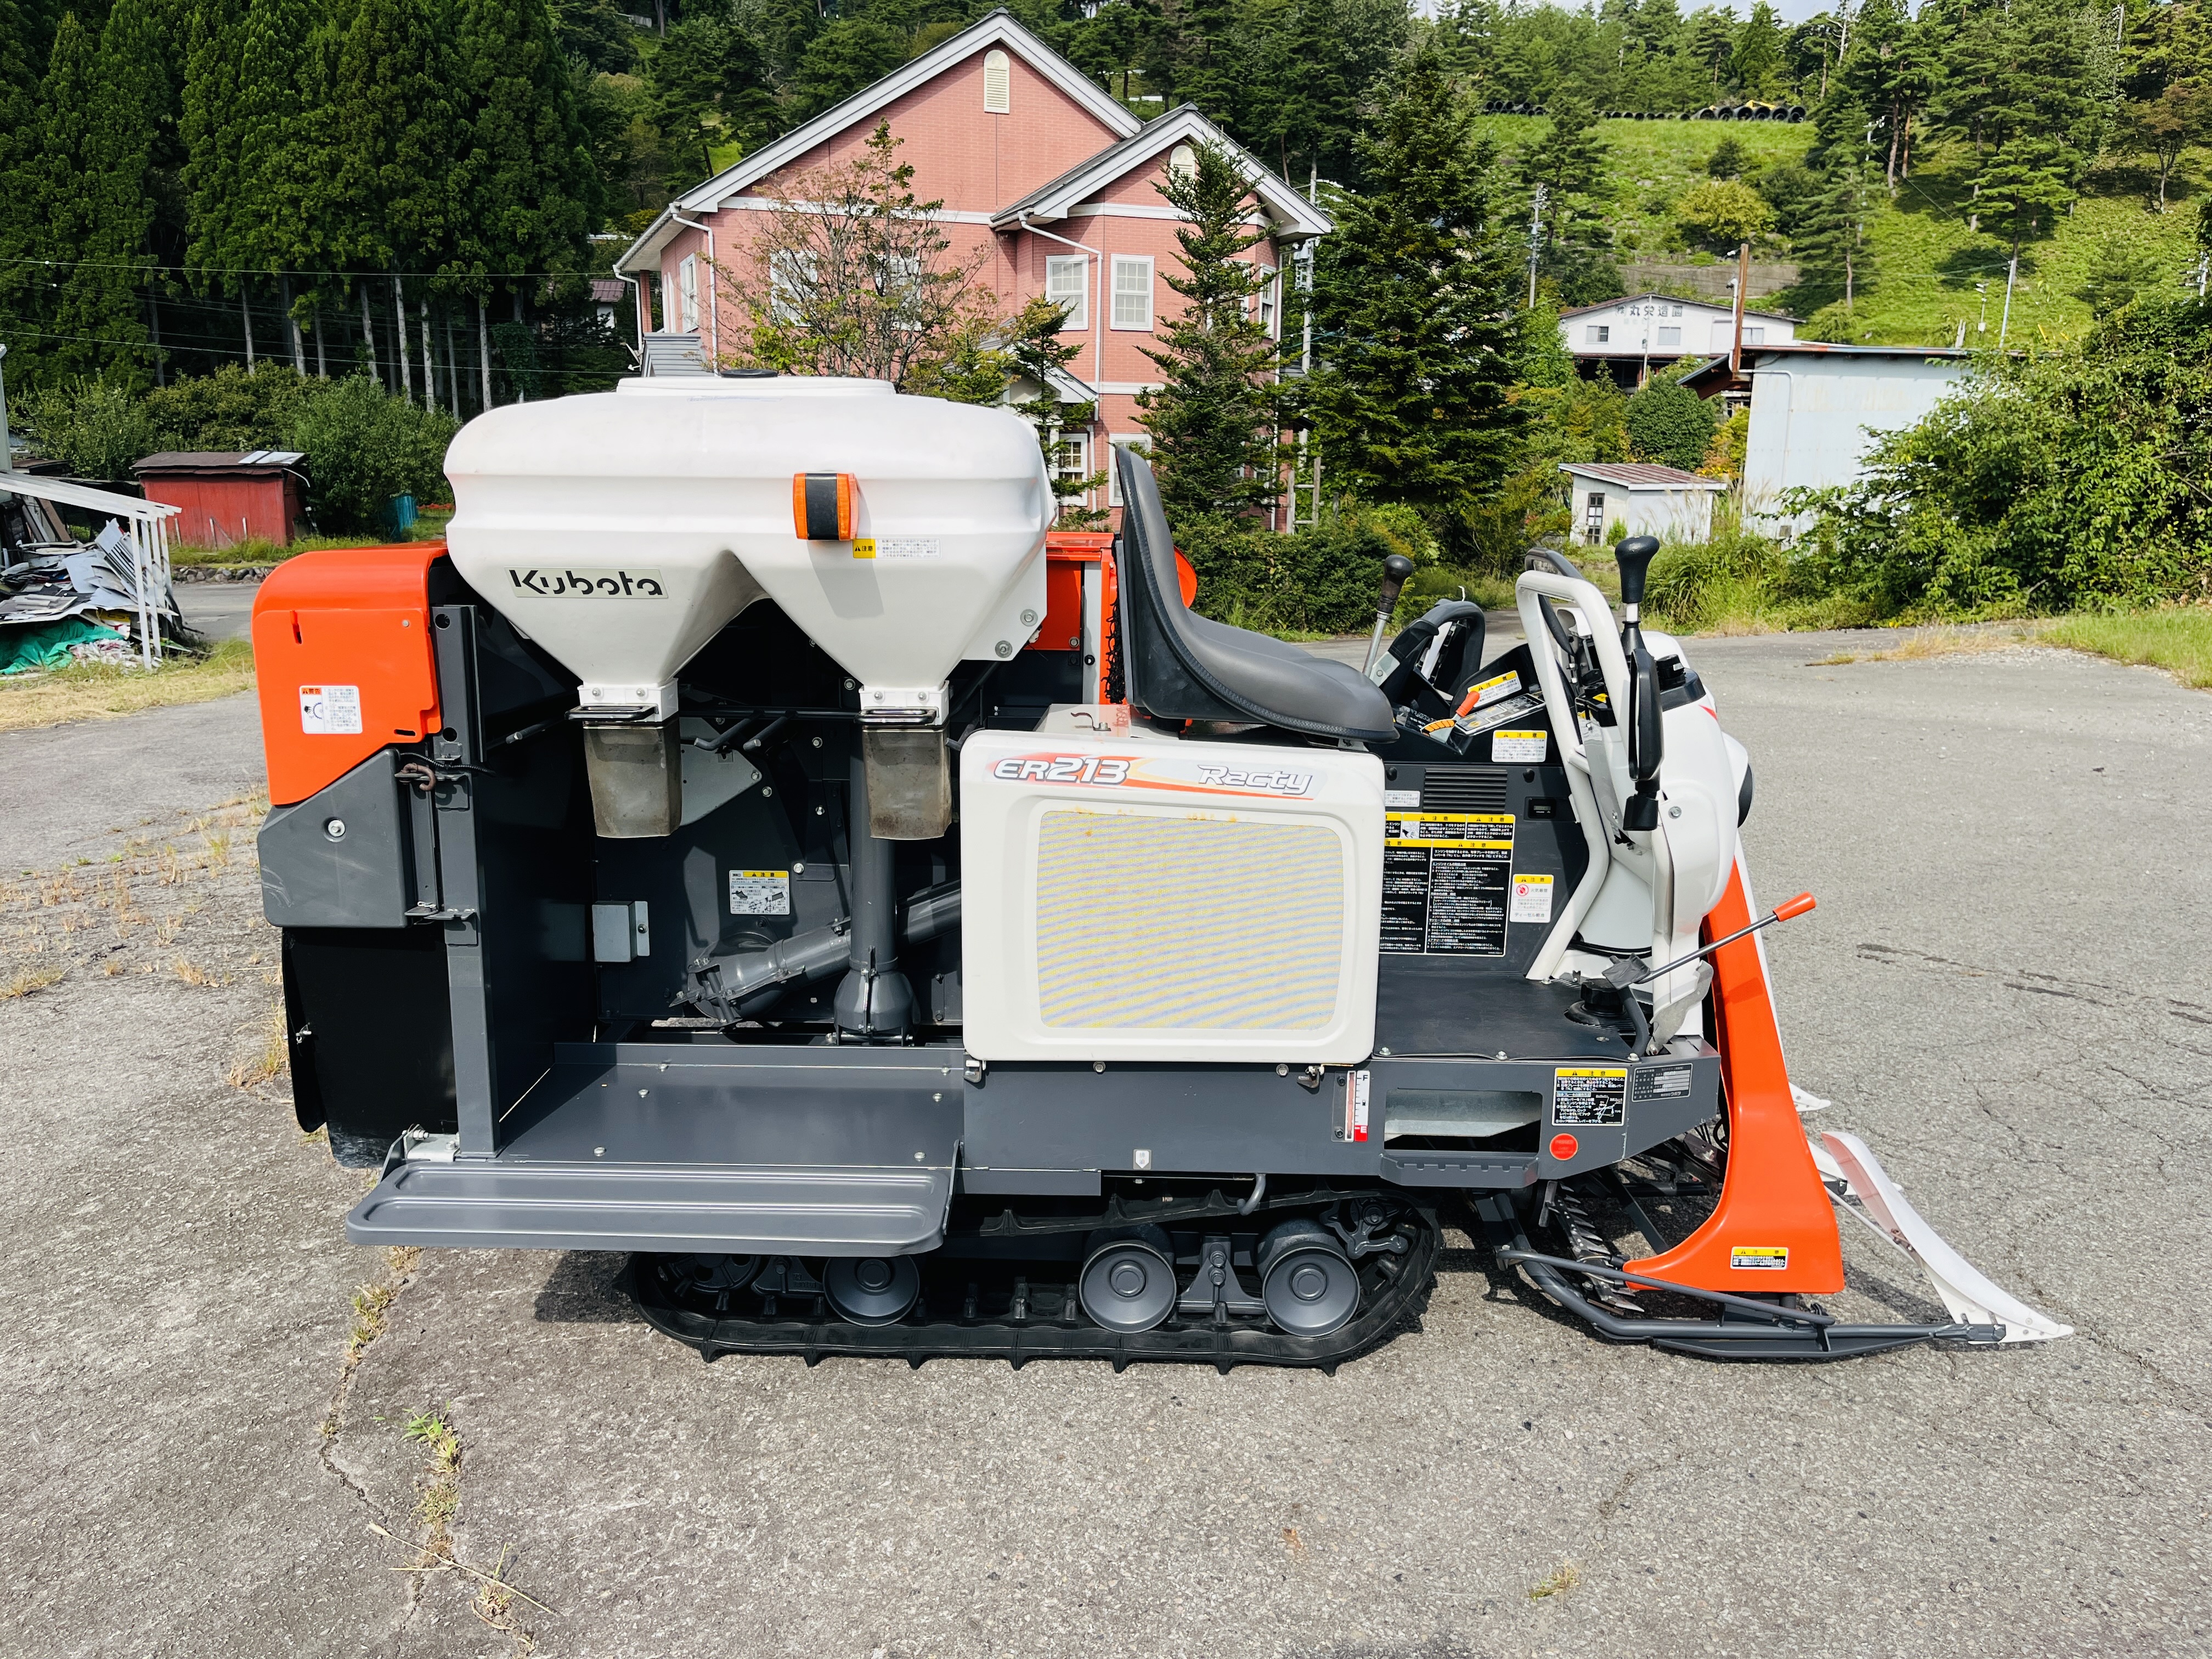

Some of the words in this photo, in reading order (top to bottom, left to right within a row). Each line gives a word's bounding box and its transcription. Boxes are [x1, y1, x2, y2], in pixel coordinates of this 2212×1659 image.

[510, 569, 663, 596] Kubota
[994, 757, 1131, 786] ER213
[1197, 764, 1314, 795] Racty
